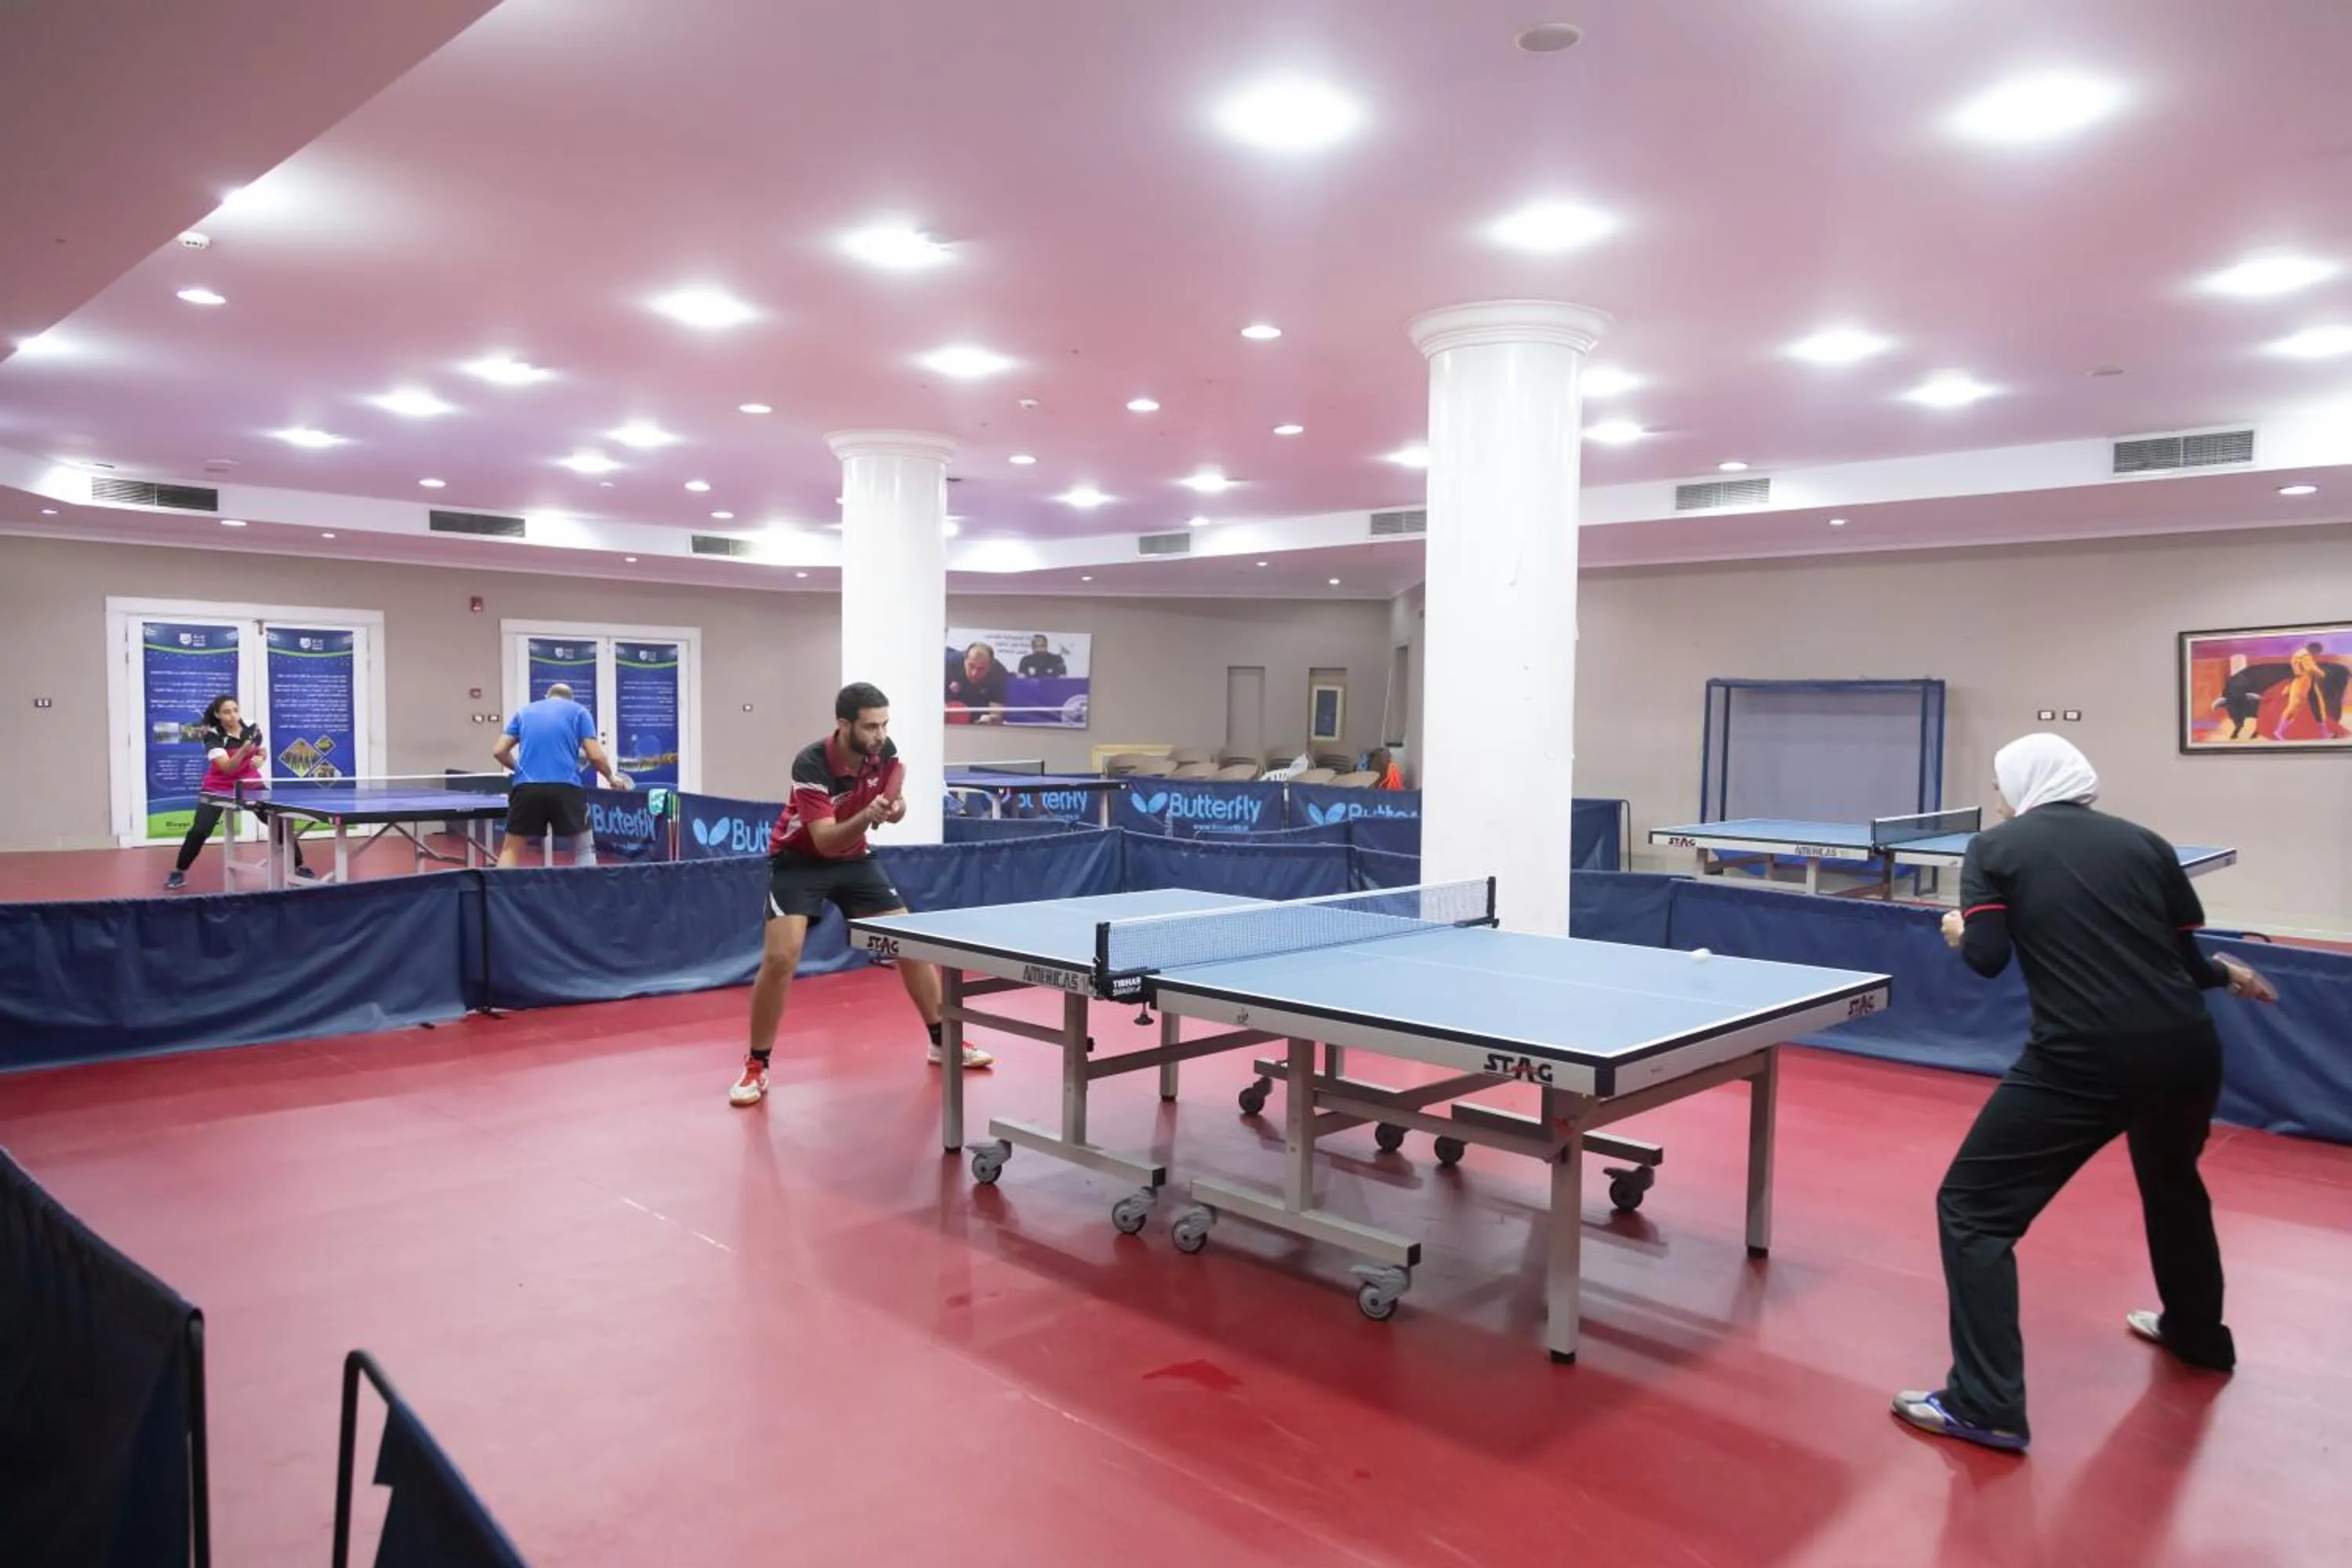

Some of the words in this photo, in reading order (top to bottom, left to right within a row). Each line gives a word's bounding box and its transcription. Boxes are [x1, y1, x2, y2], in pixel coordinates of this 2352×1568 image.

[1170, 792, 1262, 822] Butterfly
[1668, 837, 1696, 848] STAG
[866, 935, 899, 954] STAG
[1483, 1053, 1553, 1083] STAG
